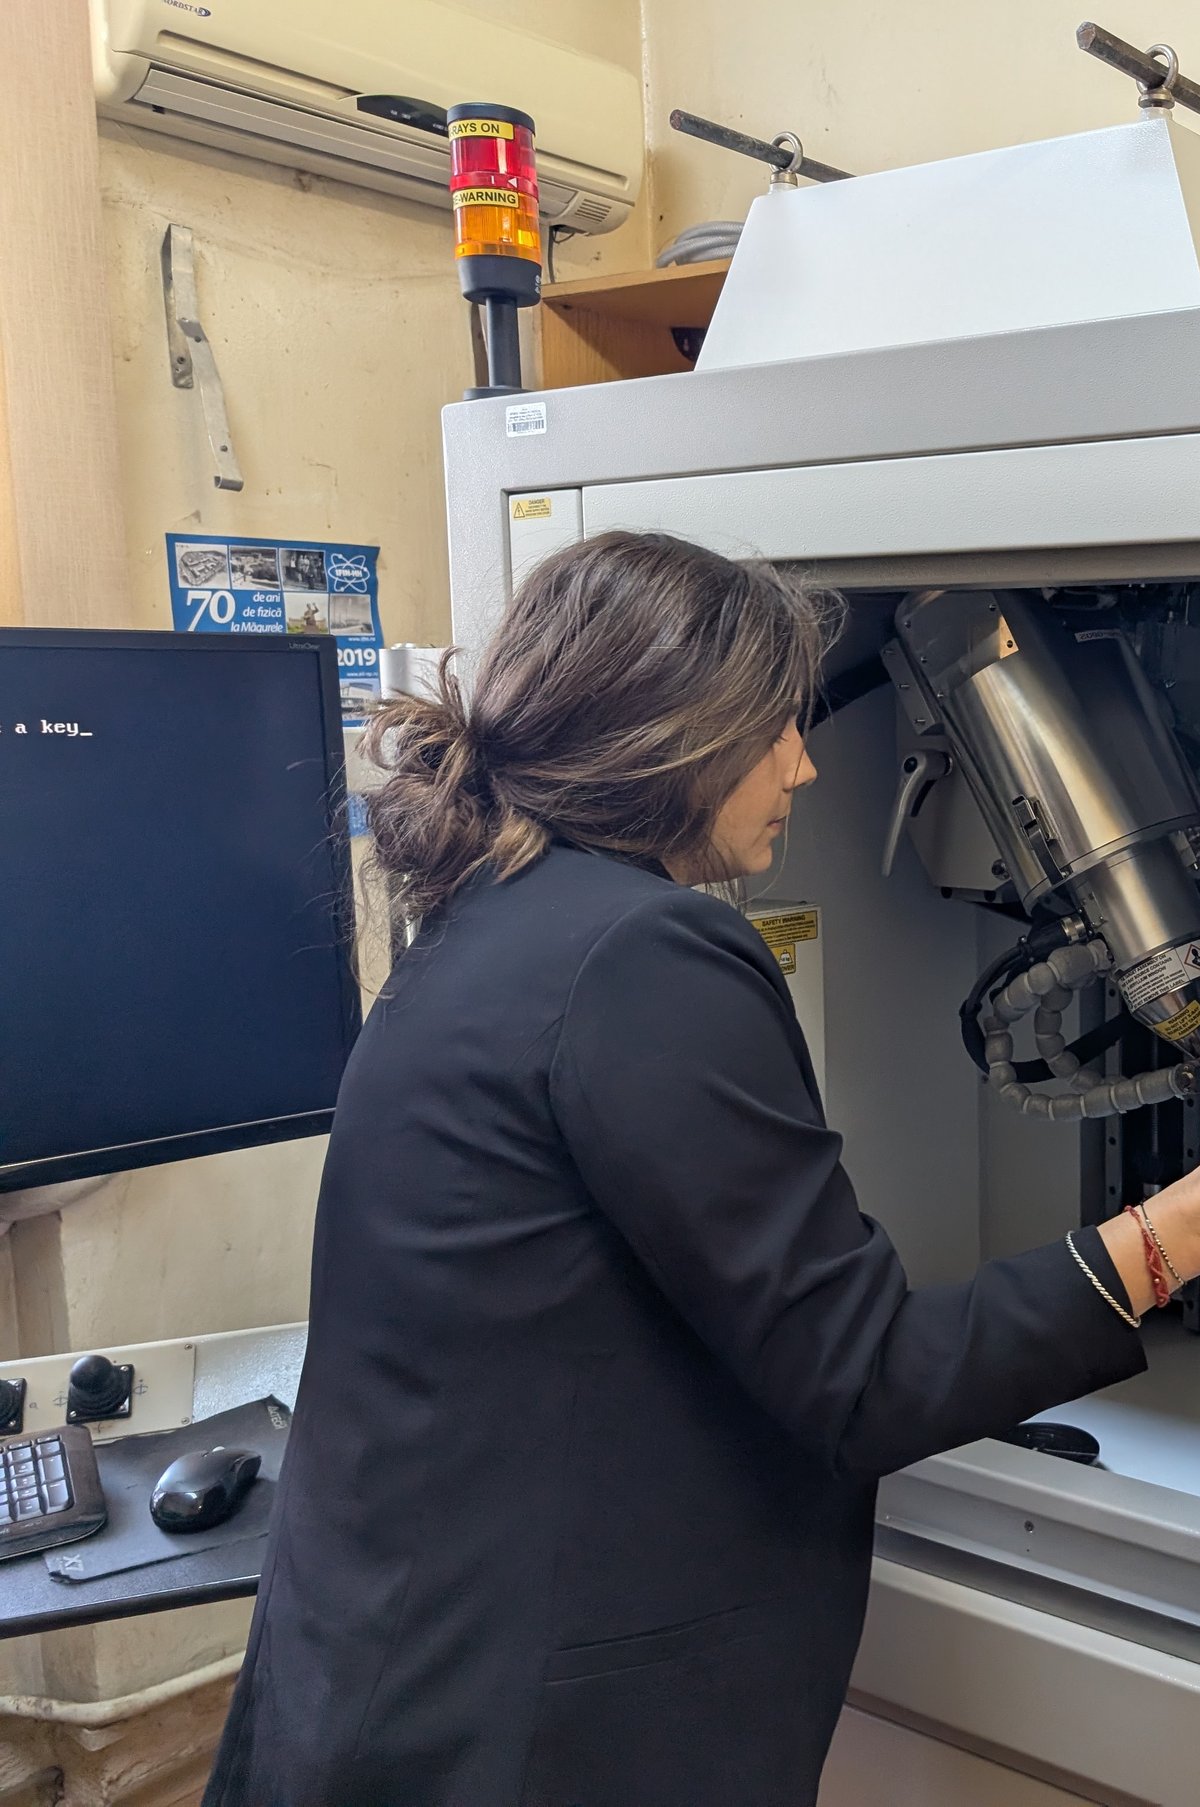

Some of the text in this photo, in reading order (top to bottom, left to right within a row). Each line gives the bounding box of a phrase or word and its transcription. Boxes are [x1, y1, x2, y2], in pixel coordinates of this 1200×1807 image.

[481, 123, 499, 133] ON
[253, 592, 280, 602] de ani
[186, 590, 236, 632] 70
[243, 607, 282, 618] de fizică
[231, 622, 283, 633] la Măgurele
[337, 649, 376, 666] 2019
[15, 723, 28, 733] a
